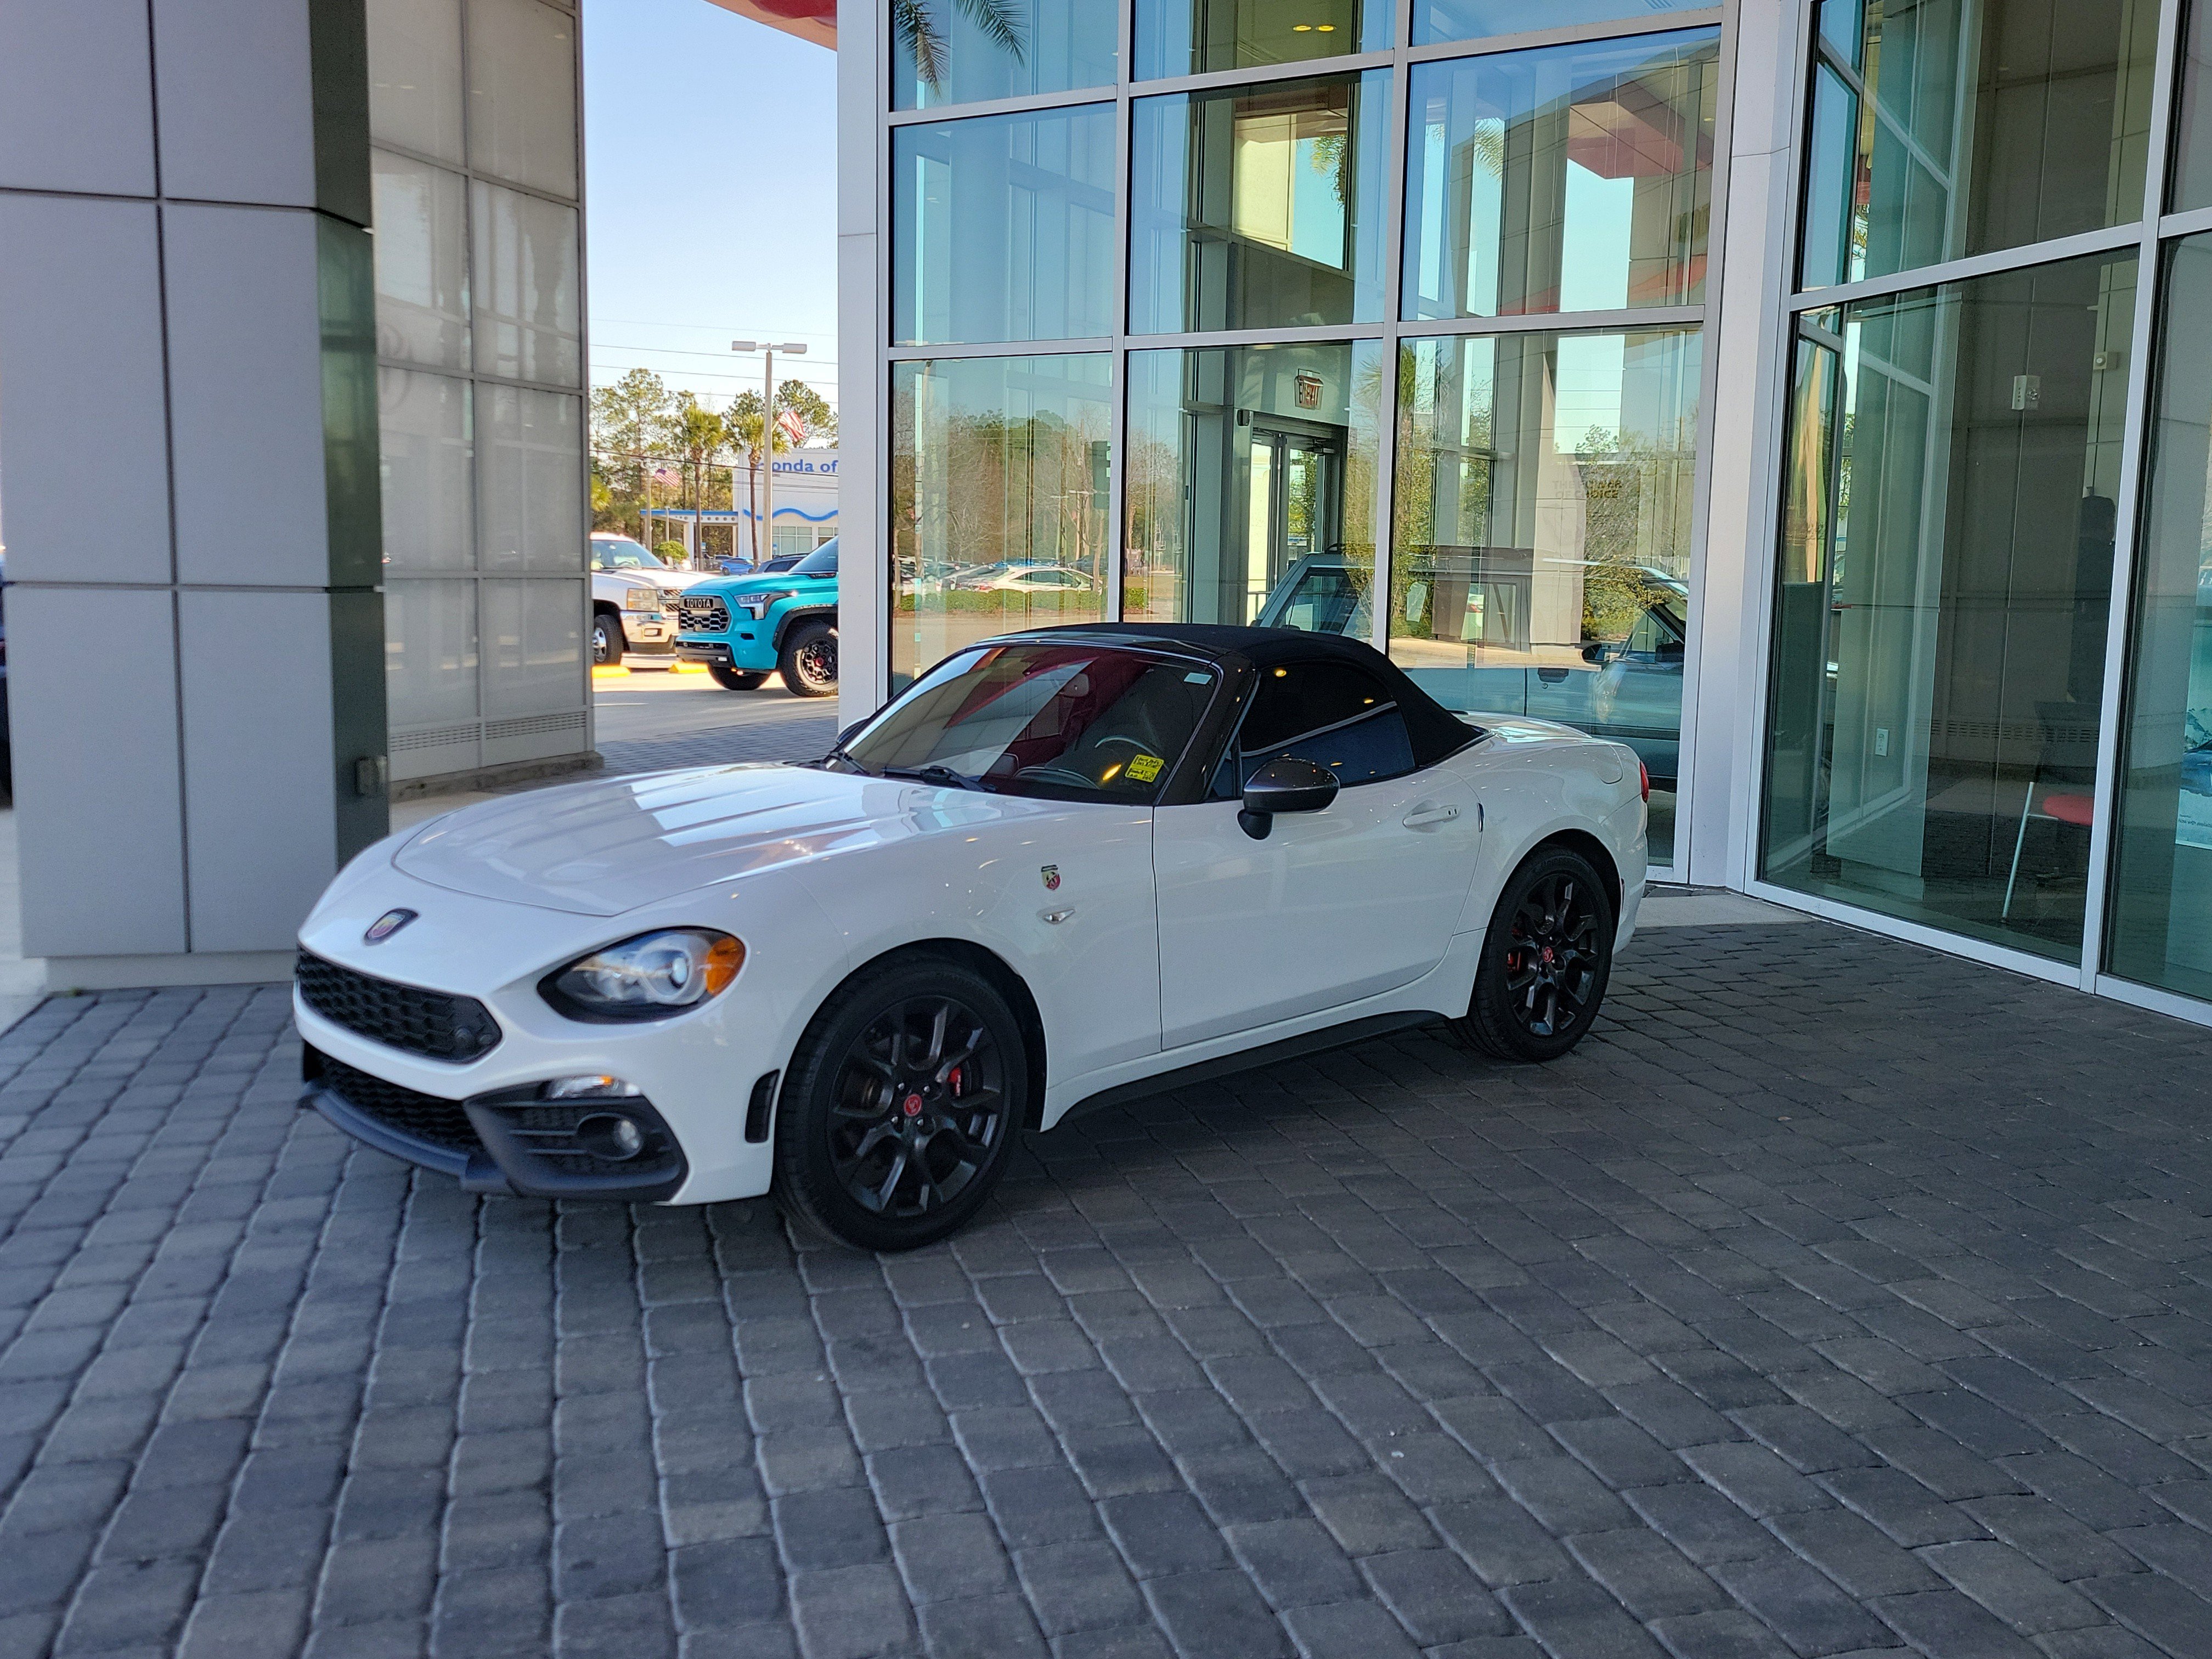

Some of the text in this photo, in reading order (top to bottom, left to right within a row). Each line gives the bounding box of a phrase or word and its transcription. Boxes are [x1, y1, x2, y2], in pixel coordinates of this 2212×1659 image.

[757, 459, 838, 472] onda of
[686, 599, 711, 607] TOYOTA
